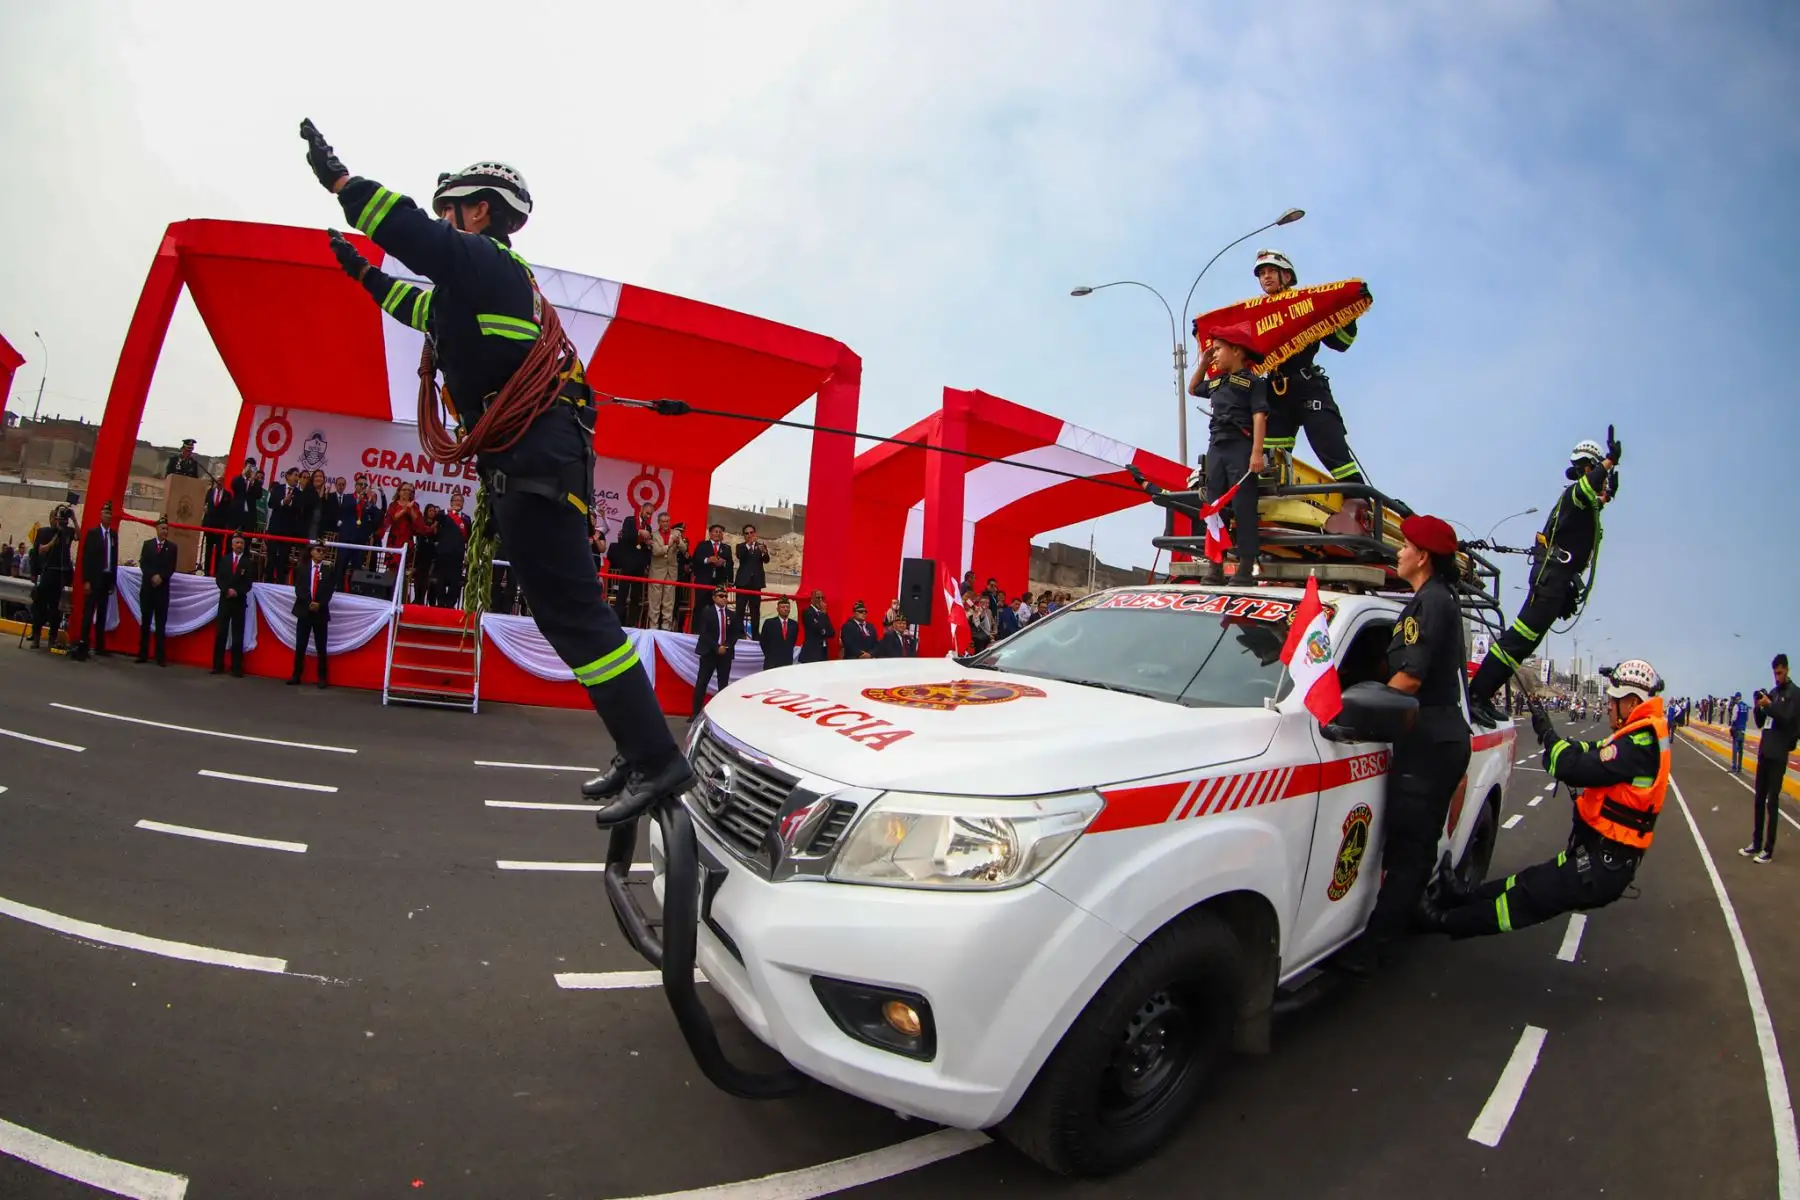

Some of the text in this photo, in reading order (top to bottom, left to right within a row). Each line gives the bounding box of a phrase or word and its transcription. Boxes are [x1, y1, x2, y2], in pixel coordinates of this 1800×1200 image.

[1256, 311, 1284, 336] KALLPA
[1288, 297, 1314, 320] UNION
[1279, 341, 1293, 357] DE
[1291, 317, 1330, 347] EMERGENCIA
[361, 447, 480, 481] GRAN DE
[415, 480, 471, 497] MILITAR
[592, 489, 619, 500] LACA
[1097, 591, 1293, 622] RESCATE
[741, 688, 915, 752] POLICIA
[1349, 752, 1388, 781] RESC
